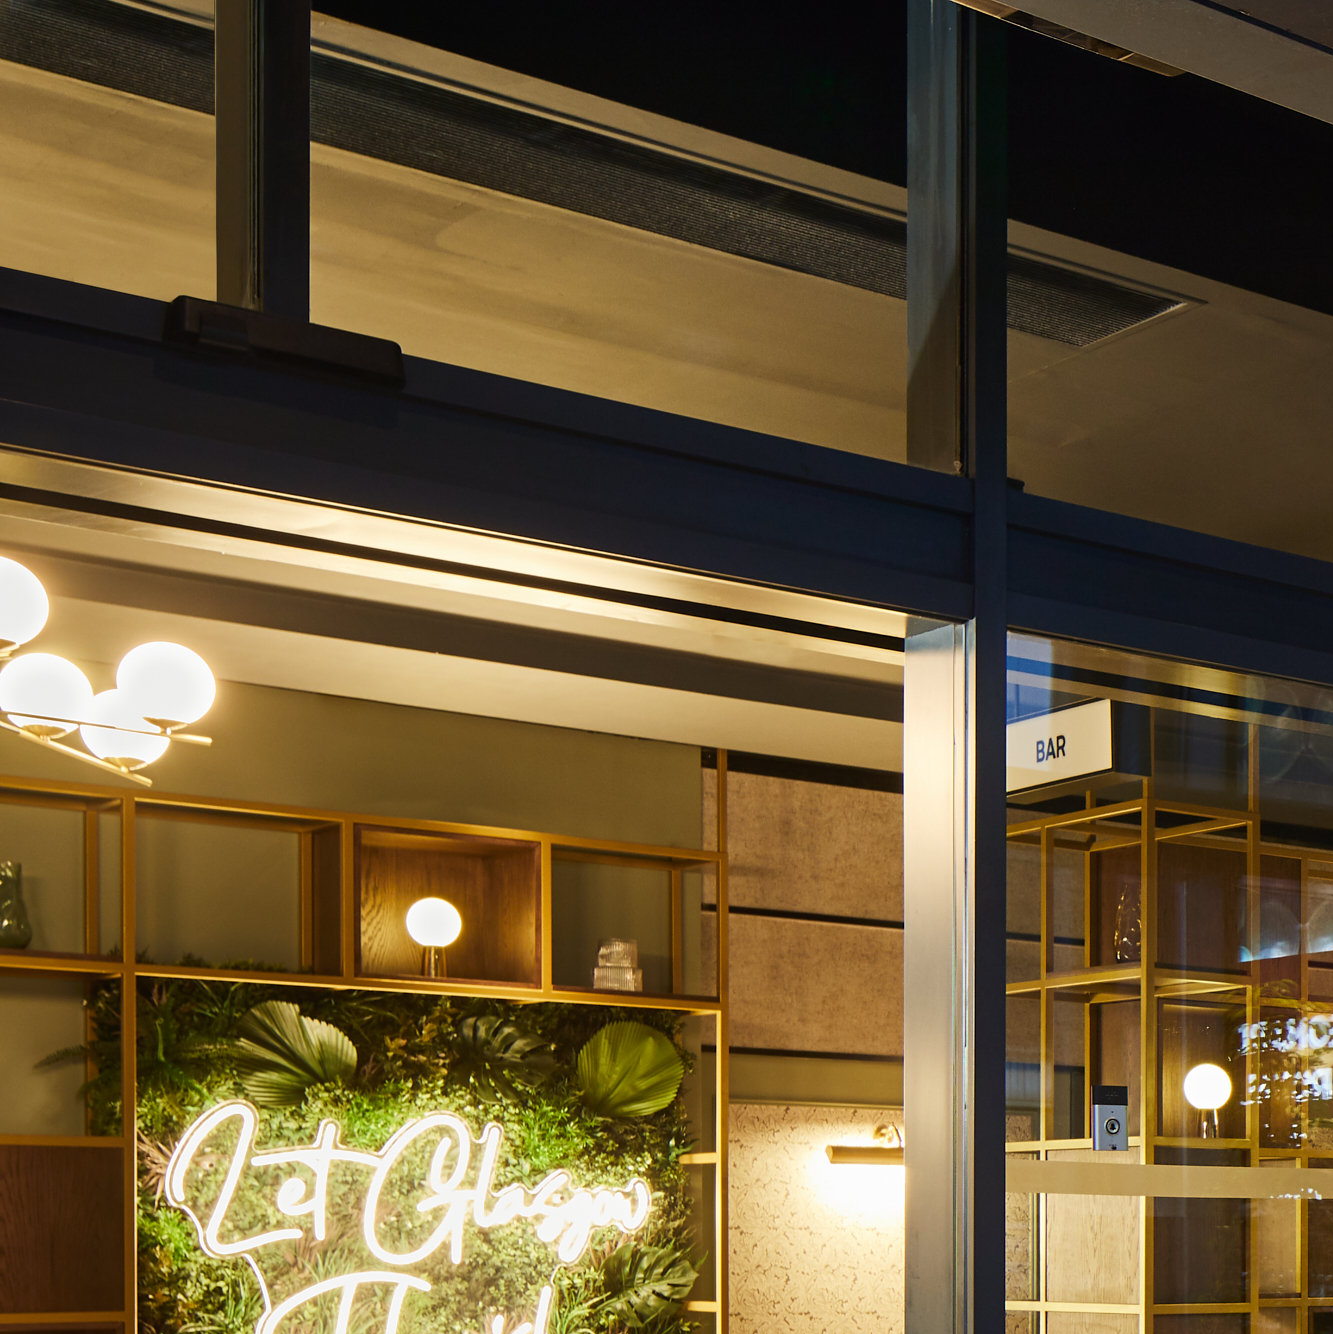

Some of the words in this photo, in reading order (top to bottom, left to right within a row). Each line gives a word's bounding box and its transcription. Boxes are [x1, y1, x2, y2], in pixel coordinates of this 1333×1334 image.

[1036, 734, 1066, 763] BAR
[171, 1103, 382, 1256] Let
[364, 1112, 651, 1266] Glasgow
